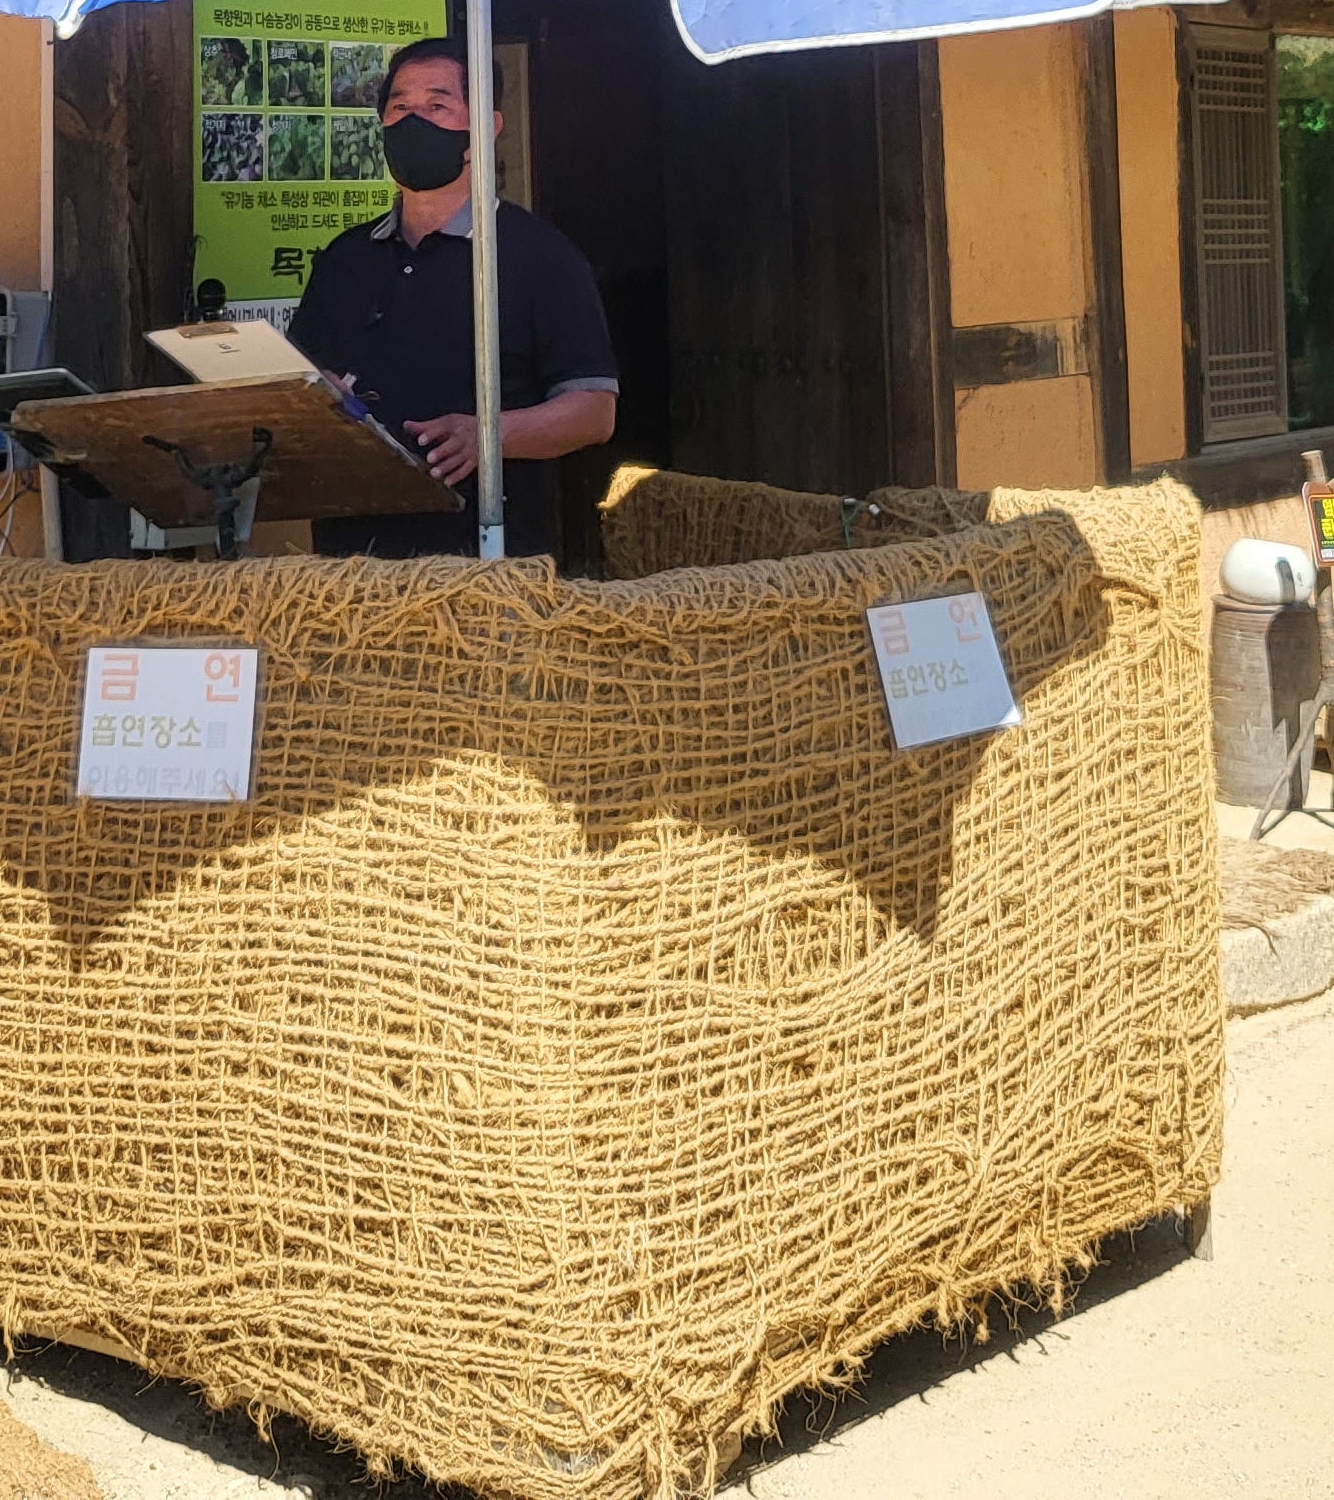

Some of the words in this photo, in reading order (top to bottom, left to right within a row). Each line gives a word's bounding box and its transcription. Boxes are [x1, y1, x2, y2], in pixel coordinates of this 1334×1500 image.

[304, 13, 341, 32] 공동으로
[343, 16, 369, 34] 생산한
[371, 17, 396, 36] 유기농
[281, 190, 309, 208] 특성상
[271, 212, 308, 231] 안심하고
[312, 213, 339, 230] 드셔도
